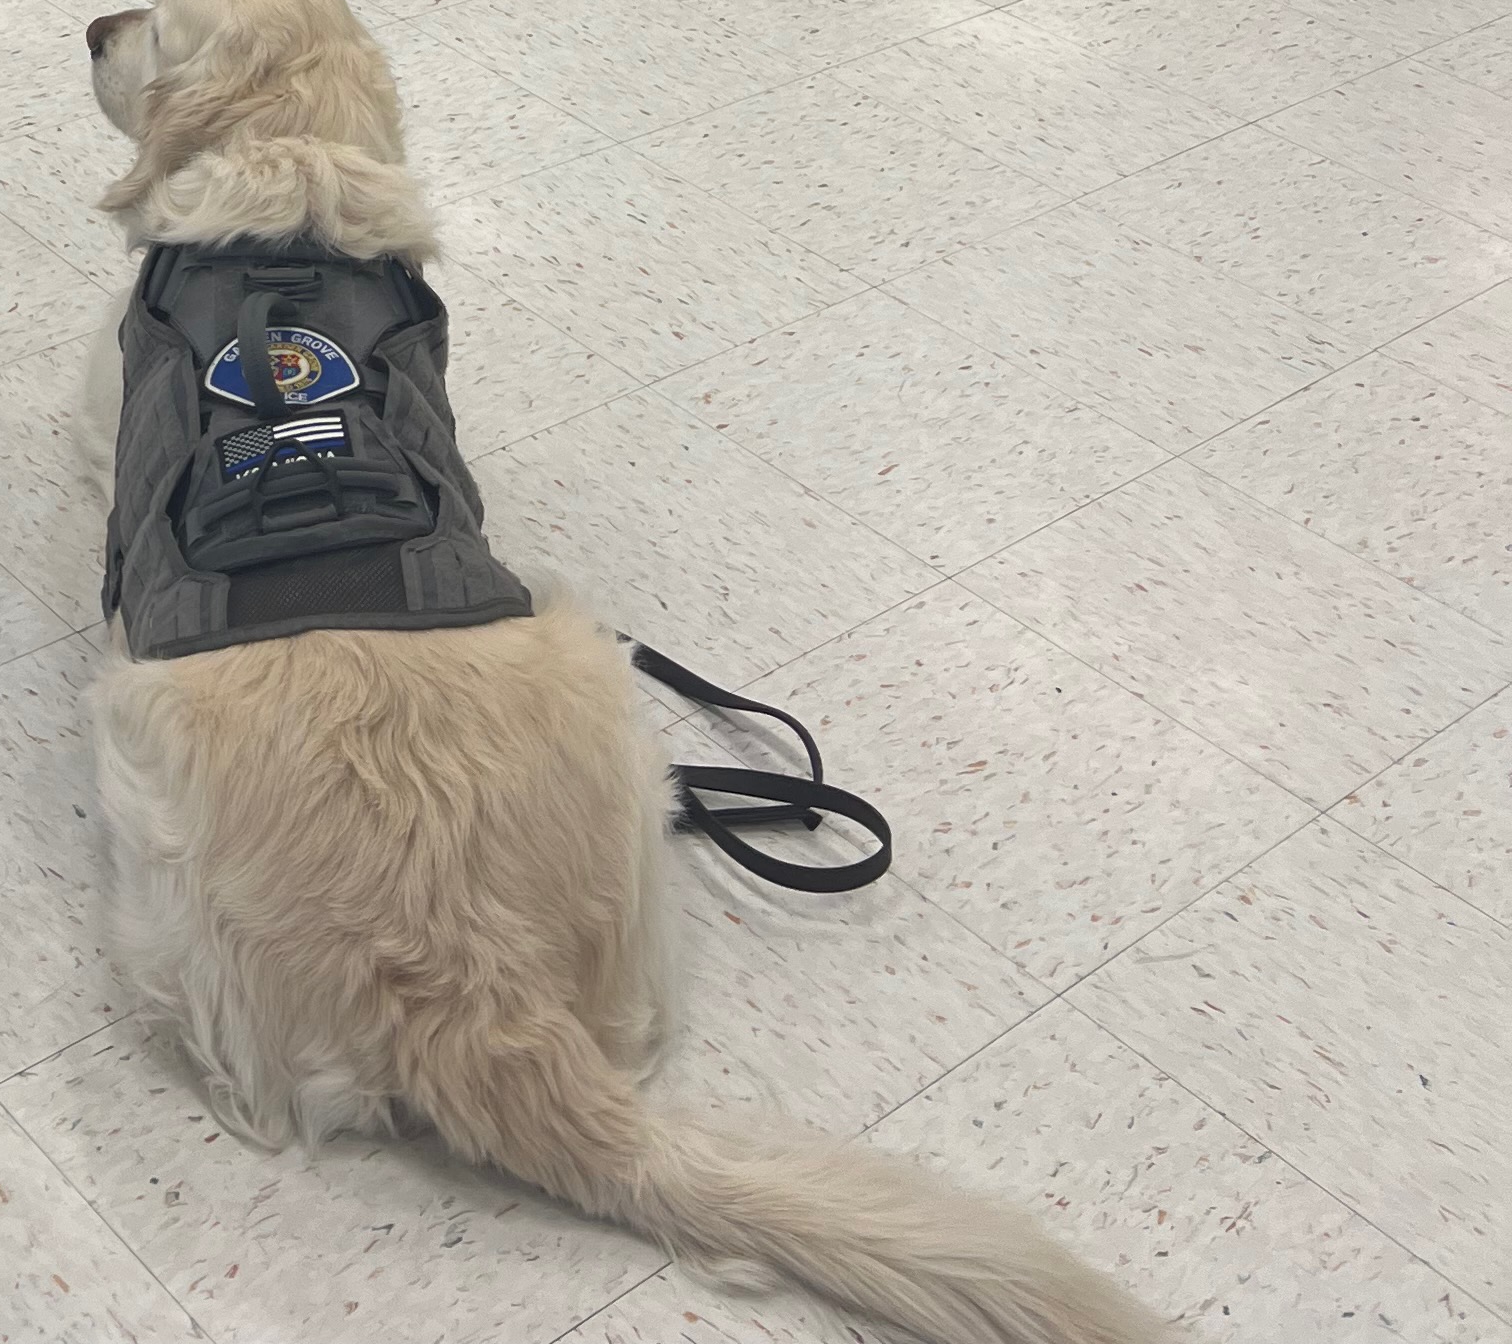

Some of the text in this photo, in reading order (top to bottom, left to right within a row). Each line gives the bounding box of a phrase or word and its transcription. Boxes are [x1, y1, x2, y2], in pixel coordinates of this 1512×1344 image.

[223, 332, 283, 363] GAEN
[290, 333, 339, 361] GROVE
[284, 392, 308, 402] ICE
